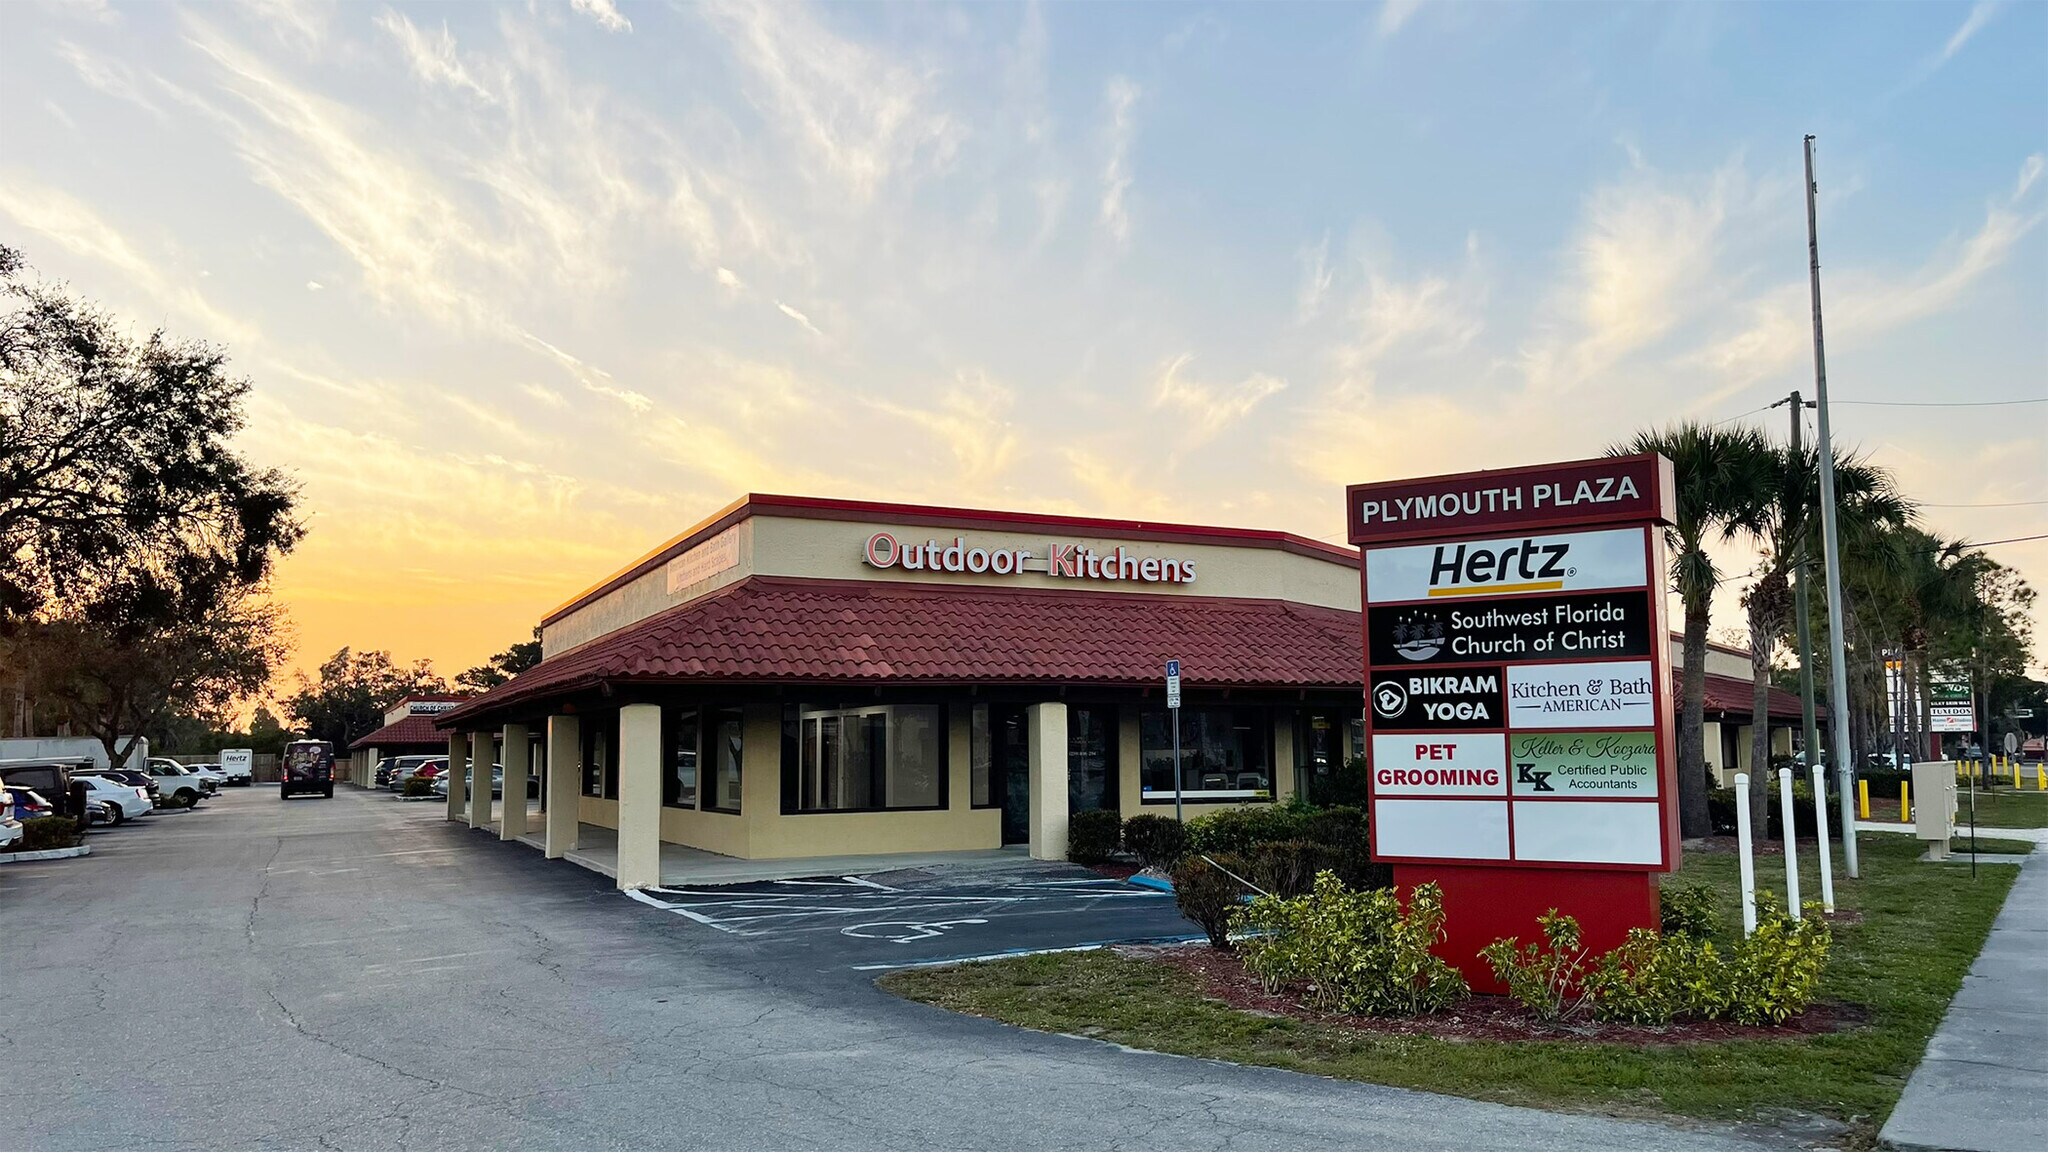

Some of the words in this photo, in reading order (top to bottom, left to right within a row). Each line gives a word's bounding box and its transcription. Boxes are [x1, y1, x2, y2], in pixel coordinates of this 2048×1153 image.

[1363, 486, 1522, 524] PLYMOUTH
[1533, 476, 1640, 508] PLAZA
[864, 532, 1031, 575] Outdoor
[1047, 543, 1198, 584] Kitchens
[1429, 539, 1570, 586] Hertz
[1451, 608, 1549, 630] Southwest
[1555, 602, 1625, 624] Florida
[1452, 633, 1526, 655] Church
[1533, 631, 1555, 651] of
[1561, 630, 1626, 650] Christ
[1409, 675, 1498, 696] BIKRAM
[1511, 680, 1581, 699] Kitchen
[1586, 679, 1604, 696] &
[1610, 677, 1653, 696] Bath
[1423, 702, 1490, 721] YOGA
[1542, 698, 1622, 713] AMERICAN
[1415, 744, 1457, 761] PET
[1512, 736, 1564, 759] Keller
[1568, 738, 1585, 756] &
[1377, 769, 1499, 786] GROOMING
[1557, 764, 1607, 776] Certified
[1610, 764, 1648, 776] Public
[1568, 778, 1638, 789] Accountants
